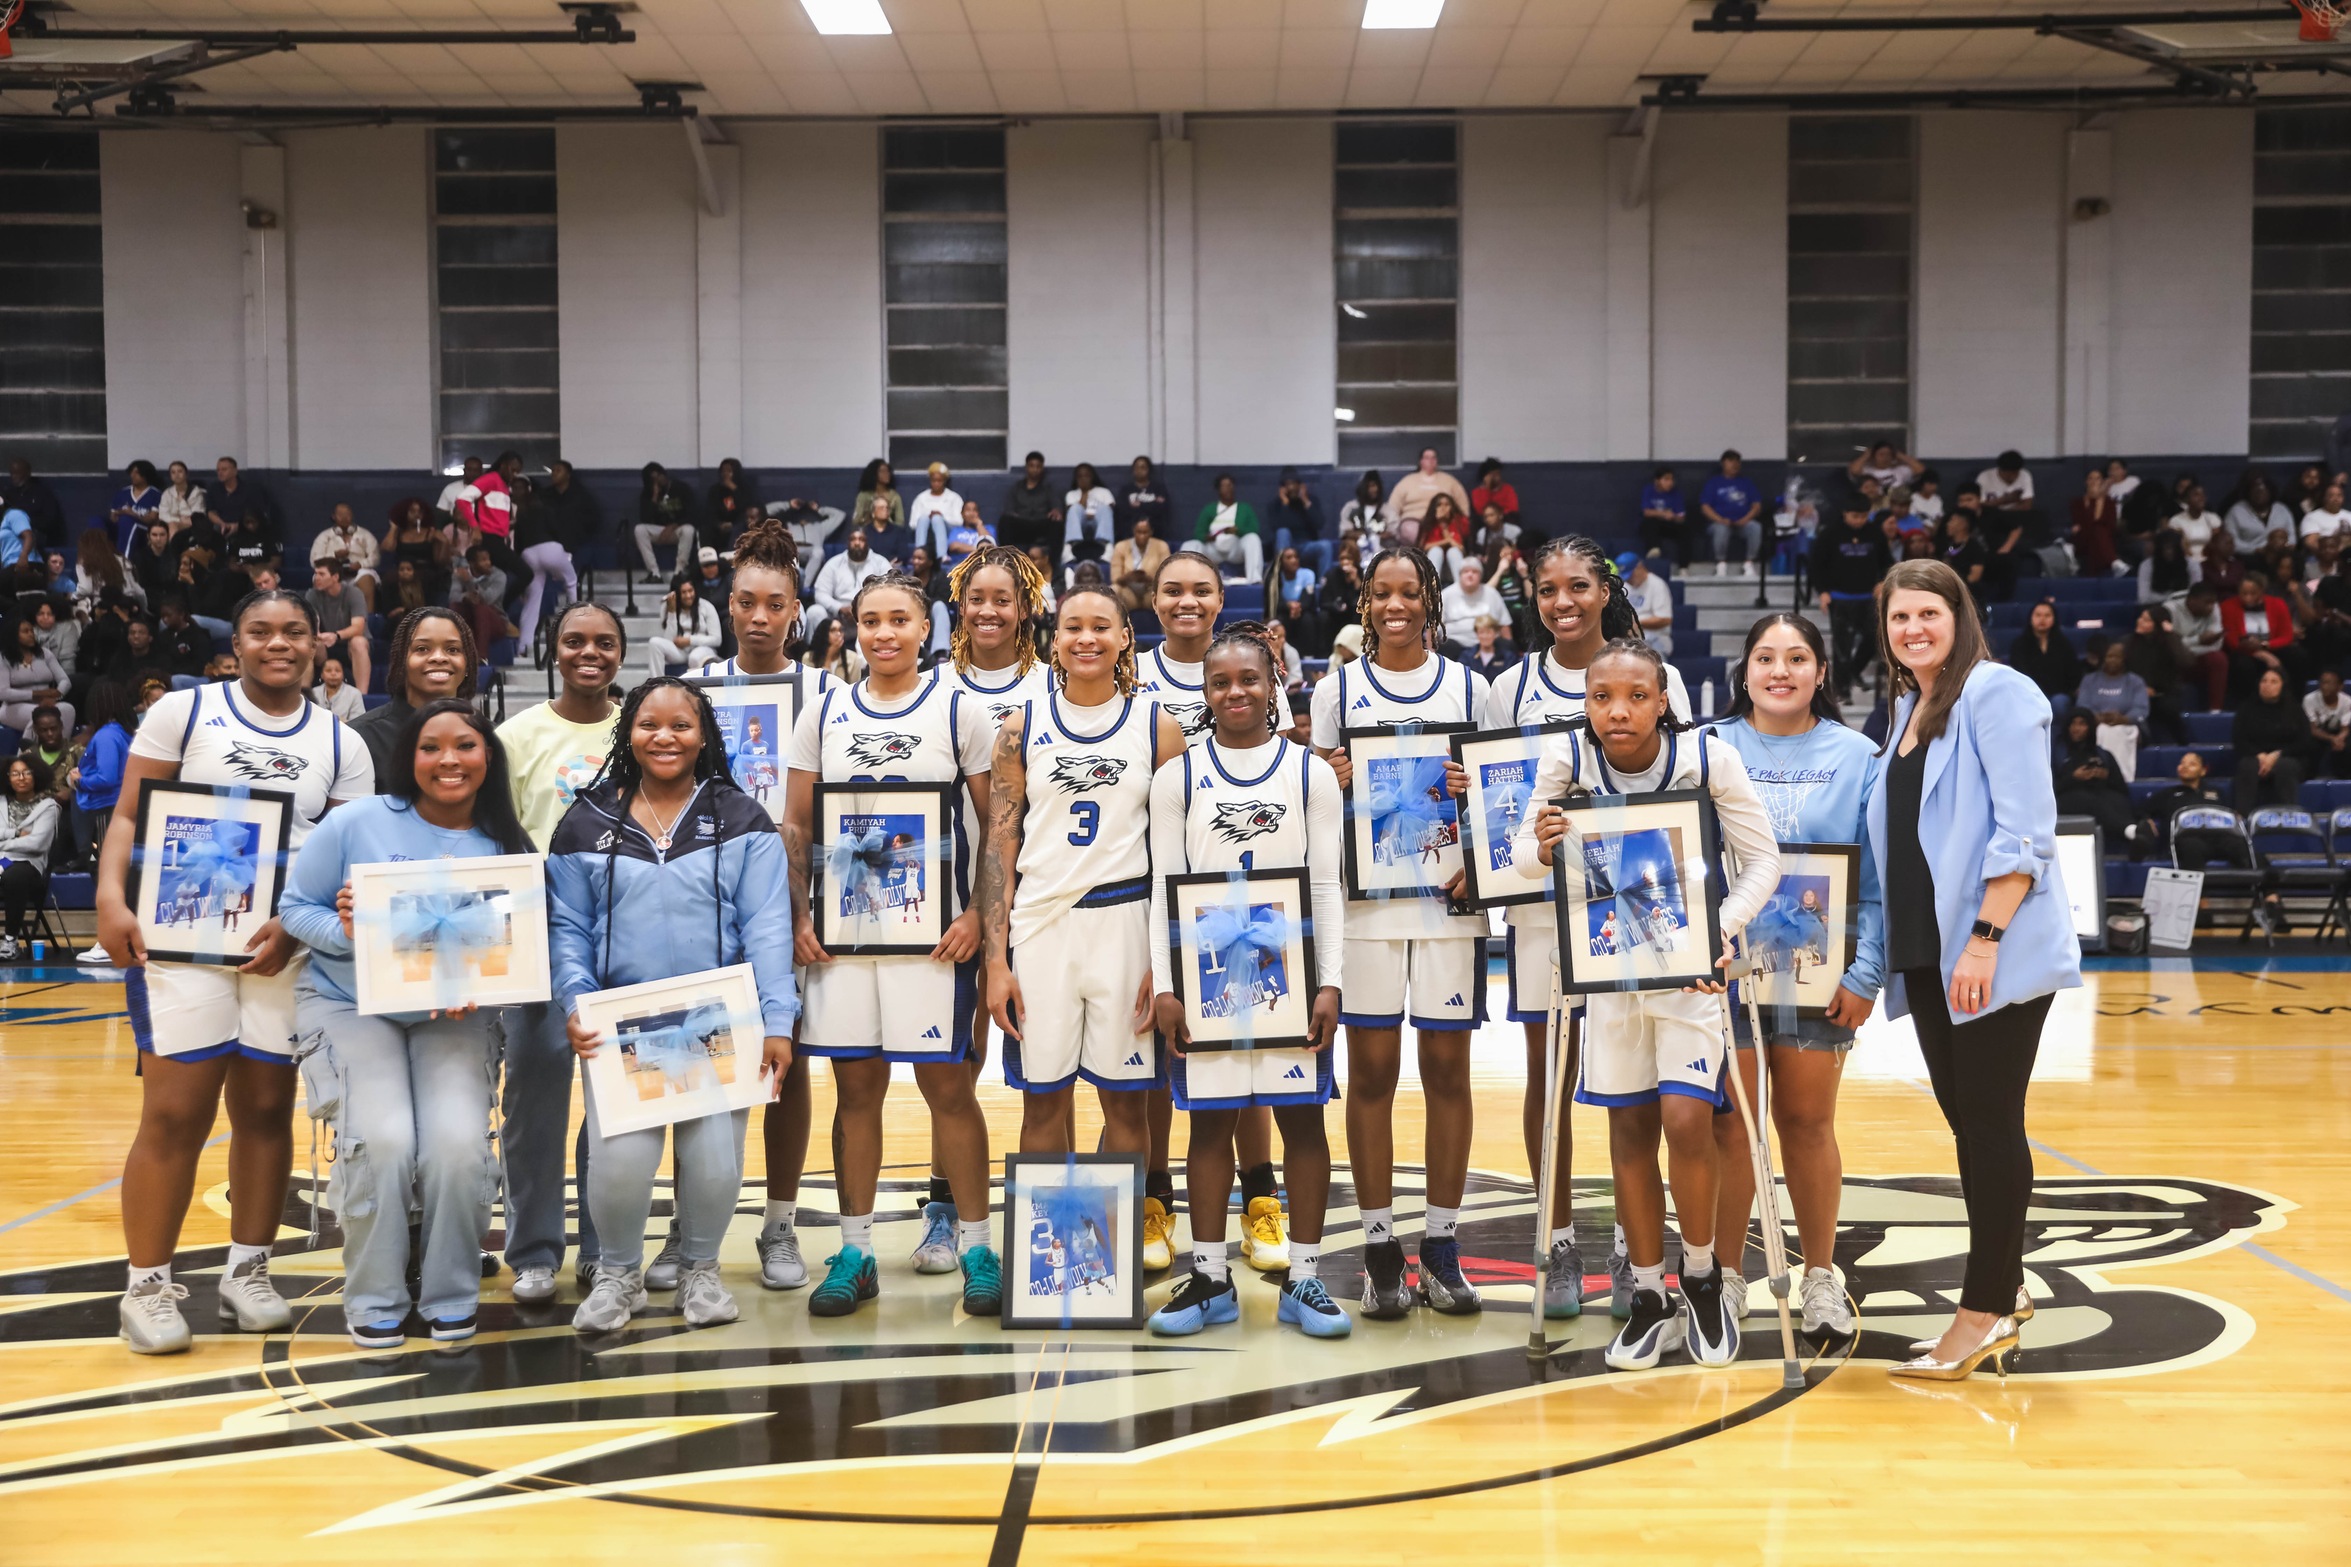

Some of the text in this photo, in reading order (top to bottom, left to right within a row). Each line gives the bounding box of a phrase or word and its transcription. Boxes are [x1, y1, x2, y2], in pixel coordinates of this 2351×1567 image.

[1376, 765, 1402, 773] AMAR
[1488, 766, 1524, 777] ZARIAH
[1759, 769, 1792, 780] PACK
[1792, 768, 1838, 780] LEGACY
[1487, 774, 1525, 785] HATTEN
[1494, 785, 1519, 814] 4
[166, 822, 212, 832] JAMYRIA
[1067, 800, 1101, 847] 3
[165, 831, 213, 840] ROBINSON
[164, 840, 183, 871] 1
[1239, 851, 1253, 870] 1
[1203, 936, 1227, 974] 1
[1031, 1218, 1054, 1255] 3
